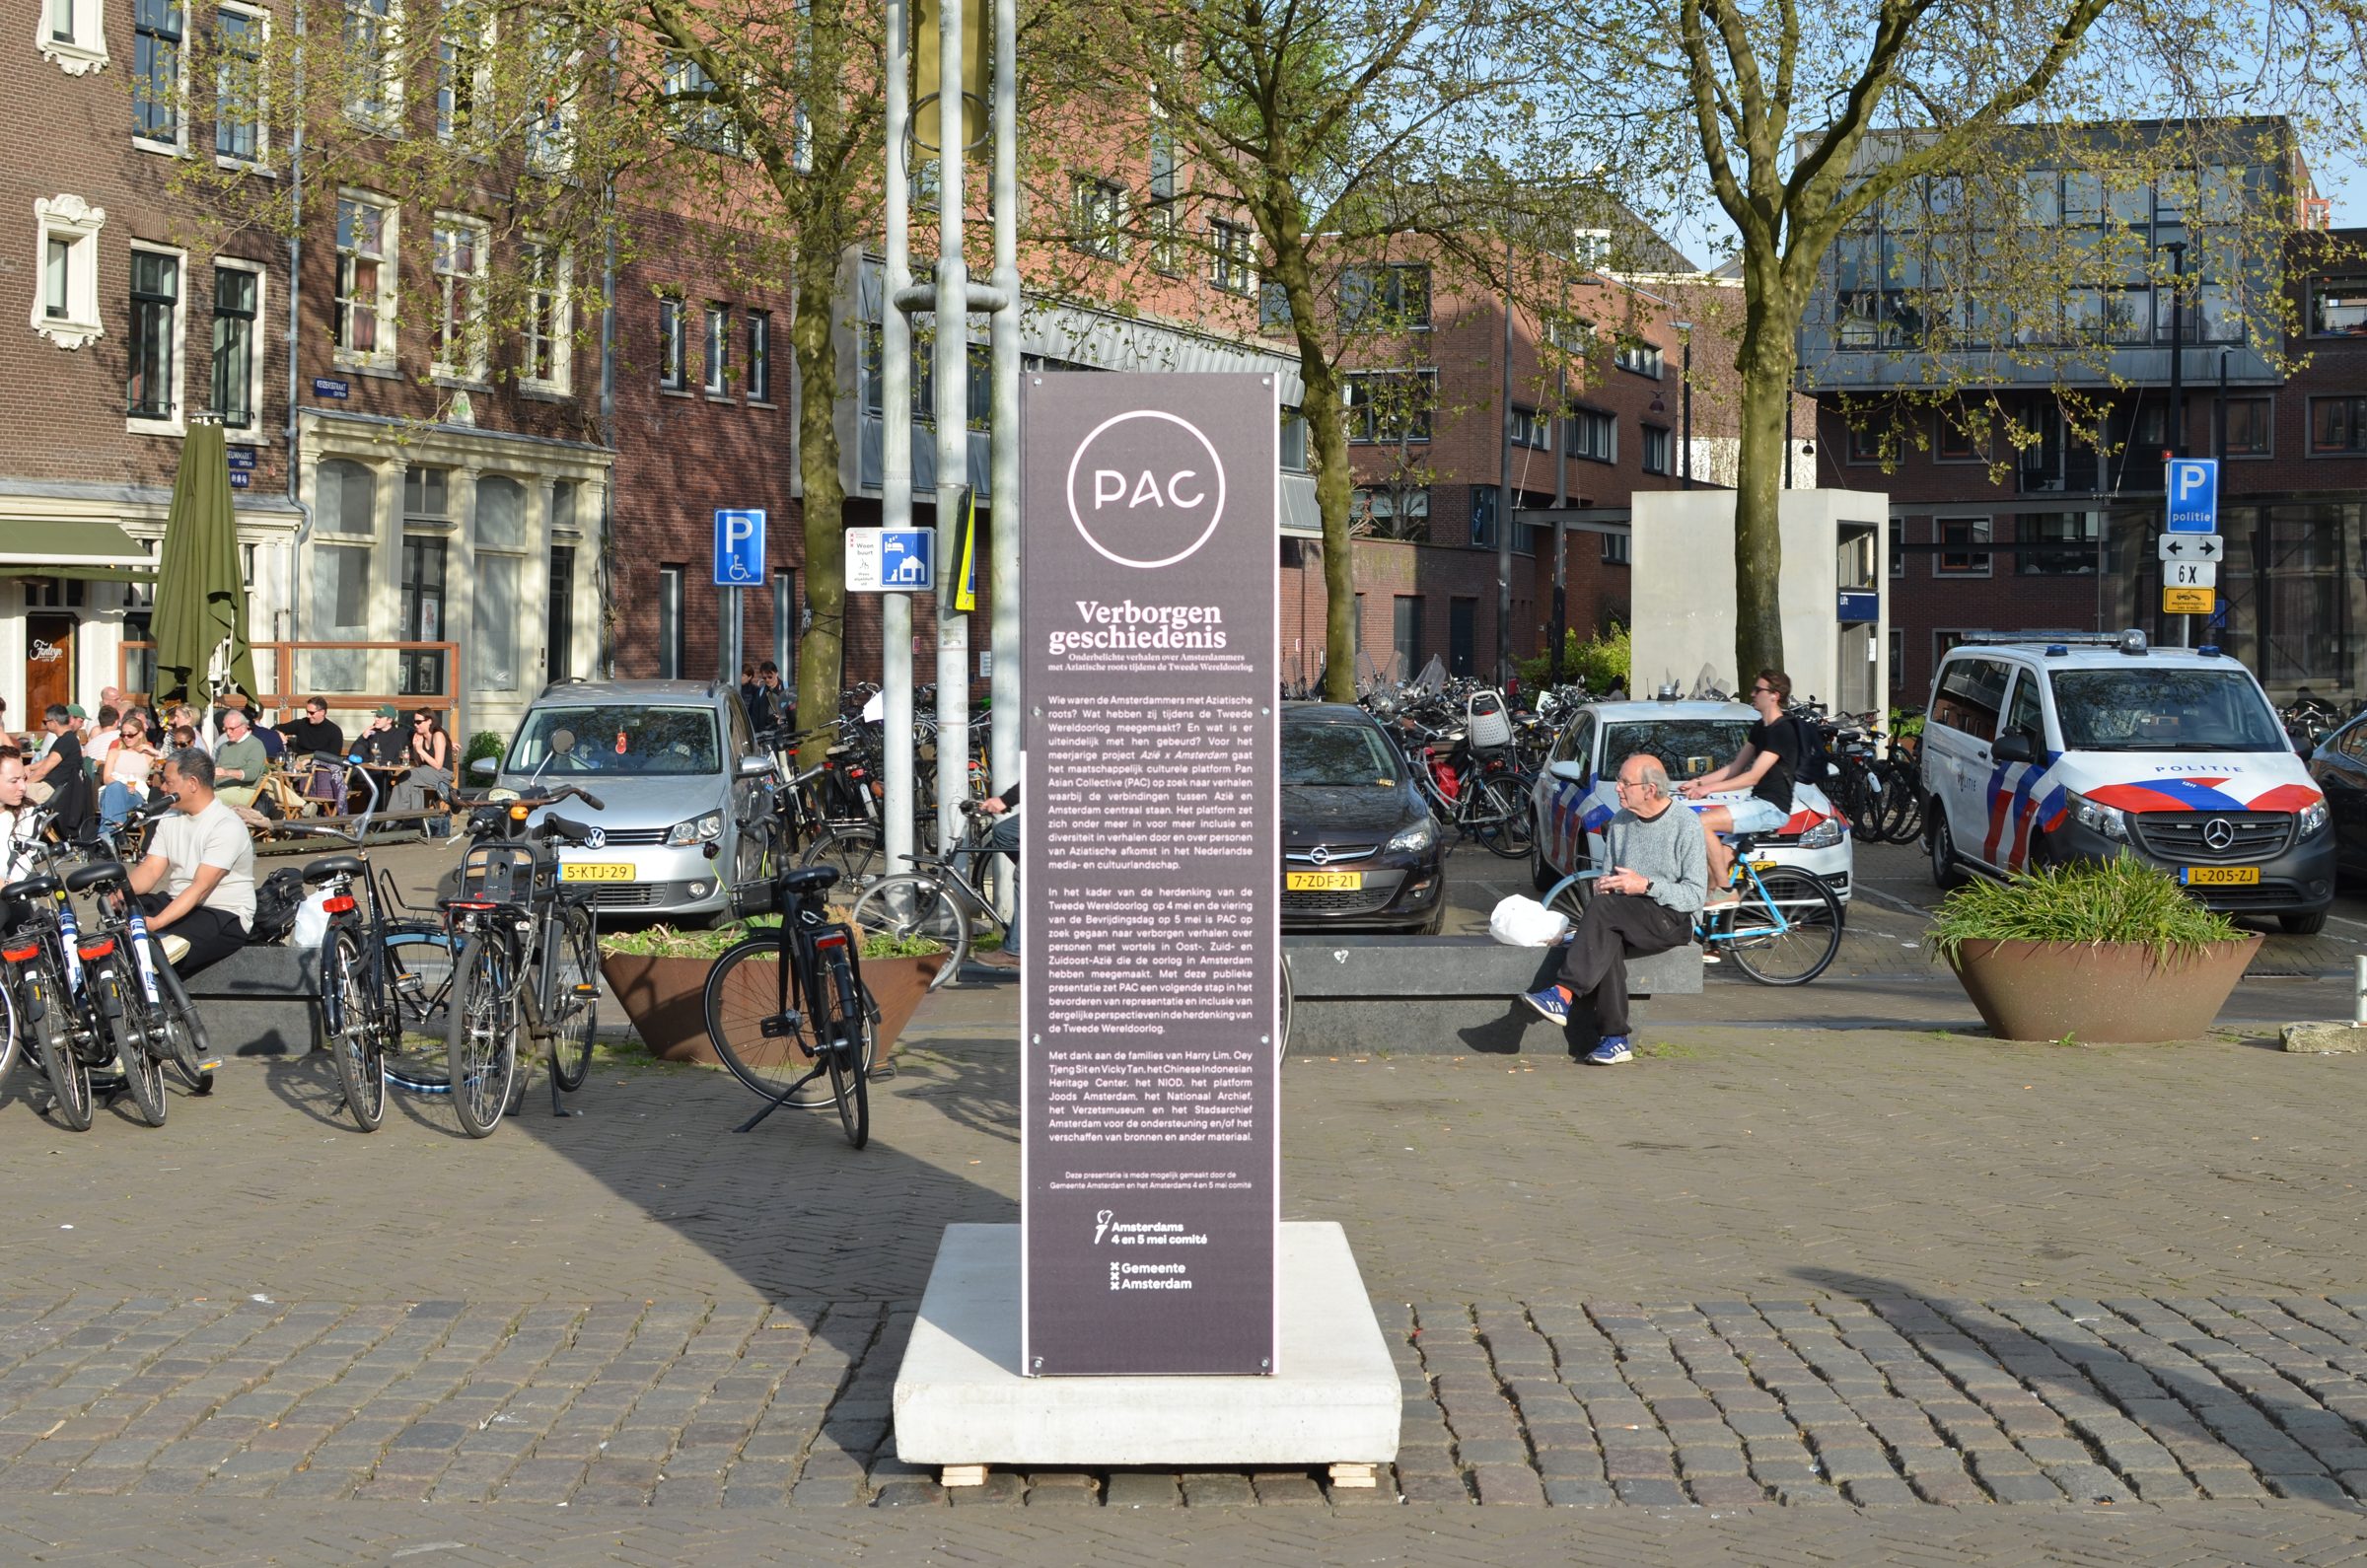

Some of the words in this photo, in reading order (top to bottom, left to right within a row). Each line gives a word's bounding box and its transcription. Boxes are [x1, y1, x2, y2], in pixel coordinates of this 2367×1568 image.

[2180, 464, 2206, 501] P
[1095, 469, 1205, 510] PAC
[2172, 511, 2211, 524] politie
[726, 516, 753, 553] P
[2178, 565, 2186, 584] 6
[2188, 565, 2197, 584] X
[1075, 600, 1222, 630] Verborgen
[1048, 624, 1227, 655] geschiedenis
[1068, 652, 1124, 661] Onderbelichte
[1130, 663, 1155, 673] tijdens
[1199, 663, 1253, 673] Wereldoorlog
[1048, 709, 1077, 718] roots?
[1147, 710, 1157, 720] zij
[1163, 710, 1193, 720] tijdens
[1217, 709, 1253, 718] Tweede
[1048, 724, 1110, 734] Wereldoorlog
[1116, 723, 1181, 734] meegemaakt?
[1187, 723, 1199, 732] En
[1048, 737, 1099, 748] uiteindelijk
[1157, 737, 1201, 748] gebeurd?
[1208, 737, 1229, 746] Voor
[1048, 750, 1097, 761] meerjarige
[1103, 750, 1134, 761] project
[1140, 750, 1160, 759] Azië
[1175, 750, 1228, 759] Amsterdam
[1232, 751, 1253, 761] gaat
[1068, 764, 1142, 775] maatschappelijk
[1147, 764, 1187, 773] culturele
[1192, 764, 1231, 774] platform
[1235, 764, 1253, 773] Pan
[1048, 778, 1073, 787] Asian
[1076, 778, 1122, 787] Collective
[1124, 778, 1150, 789] (PAC)
[1167, 778, 1187, 787] zoek
[1213, 778, 1253, 787] verhalen
[1048, 792, 1081, 802] waarbij
[1089, 792, 1101, 801] de
[1109, 792, 1170, 803] verbindingen
[1214, 792, 1234, 801] Azië
[1048, 806, 1101, 815] Amsterdam
[1105, 806, 1142, 815] centraal
[1177, 806, 1192, 815] Het
[1196, 806, 1235, 816] platform
[1048, 820, 1067, 828] zich
[1072, 820, 1099, 828] onder
[1200, 820, 1236, 828] inclusie
[1048, 833, 1094, 842] diversiteit
[1109, 832, 1147, 841] verhalen
[1209, 834, 1253, 843] personen
[1069, 846, 1116, 855] Aziatische
[1121, 846, 1157, 855] afkomst
[1194, 846, 1253, 855] Nederlandse
[1048, 860, 1081, 869] media-
[1097, 860, 1181, 870] cultuurlandschap.
[567, 866, 627, 879] 5-KTJ-29
[2194, 870, 2254, 882] L-205-ZJ
[1294, 875, 1354, 889] 7-ZDF-21
[1064, 888, 1079, 896] het
[1086, 888, 1112, 896] kader
[1141, 888, 1153, 896] de
[1160, 888, 1211, 898] herdenking
[1241, 888, 1253, 896] de
[1049, 1105, 1064, 1114] het
[1072, 1105, 1144, 1114] Verzetsmuseum
[1172, 1105, 1187, 1114] het
[1195, 1105, 1253, 1114] Stadsarchief
[1049, 1119, 1101, 1128] Amsterdam
[1141, 1119, 1207, 1129] ondersteuning
[1210, 1118, 1235, 1129] en/of
[1237, 1118, 1252, 1127] het
[1049, 1132, 1103, 1142] verschaffen
[1124, 1132, 1163, 1141] bronnen
[1180, 1132, 1205, 1141] ander
[1208, 1132, 1252, 1141] materiaal.
[1112, 1222, 1184, 1233] Amsterdams
[1112, 1235, 1119, 1245] 4
[1121, 1236, 1135, 1245] en
[1137, 1235, 1144, 1245] 5
[1147, 1235, 1167, 1245] mei
[1169, 1234, 1207, 1245] comité
[1121, 1262, 1186, 1274] Gemeente
[1121, 1278, 1192, 1290] Amsterdam
